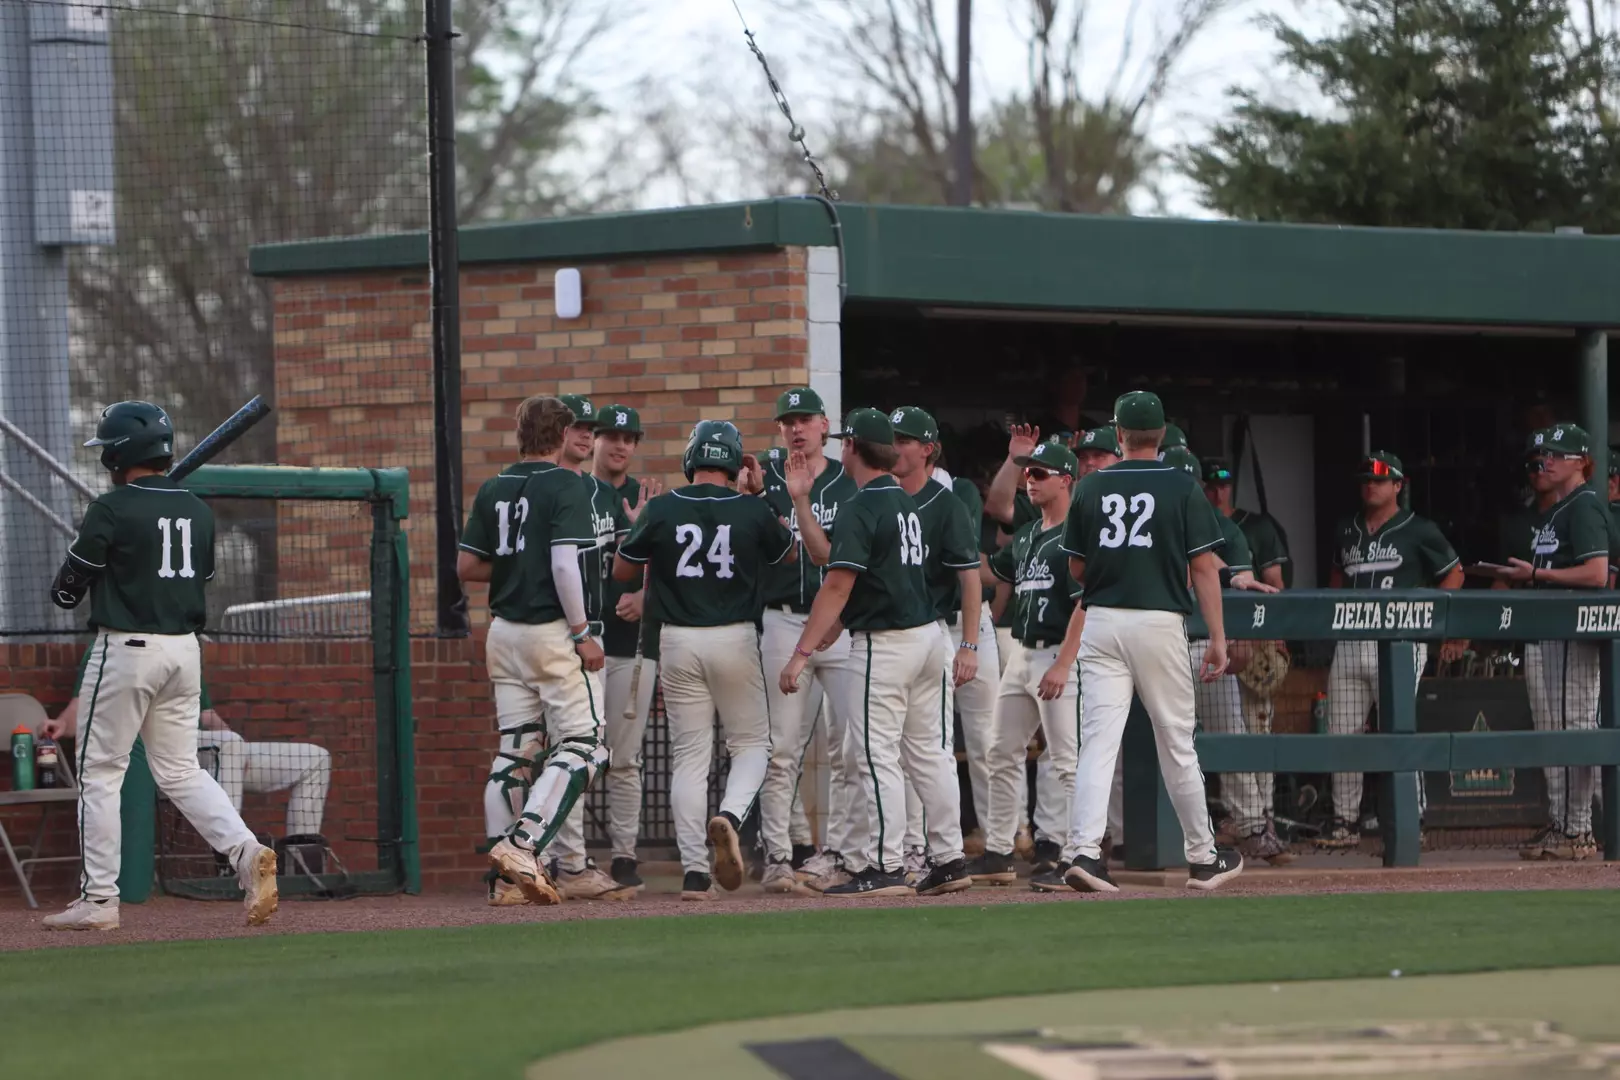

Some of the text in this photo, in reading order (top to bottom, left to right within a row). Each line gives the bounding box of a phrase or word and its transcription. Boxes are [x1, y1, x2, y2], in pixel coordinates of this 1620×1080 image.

[721, 451, 729, 459] 24
[495, 496, 529, 556] 12
[811, 501, 839, 525] Stat
[1099, 492, 1156, 548] 32
[157, 517, 195, 578] 11
[675, 523, 734, 578] 24
[1367, 541, 1398, 561] State
[1037, 596, 1049, 623] 7
[1332, 601, 1434, 630] DELTA STATE
[1576, 605, 1620, 632] DELTA
[13, 743, 27, 758] G
